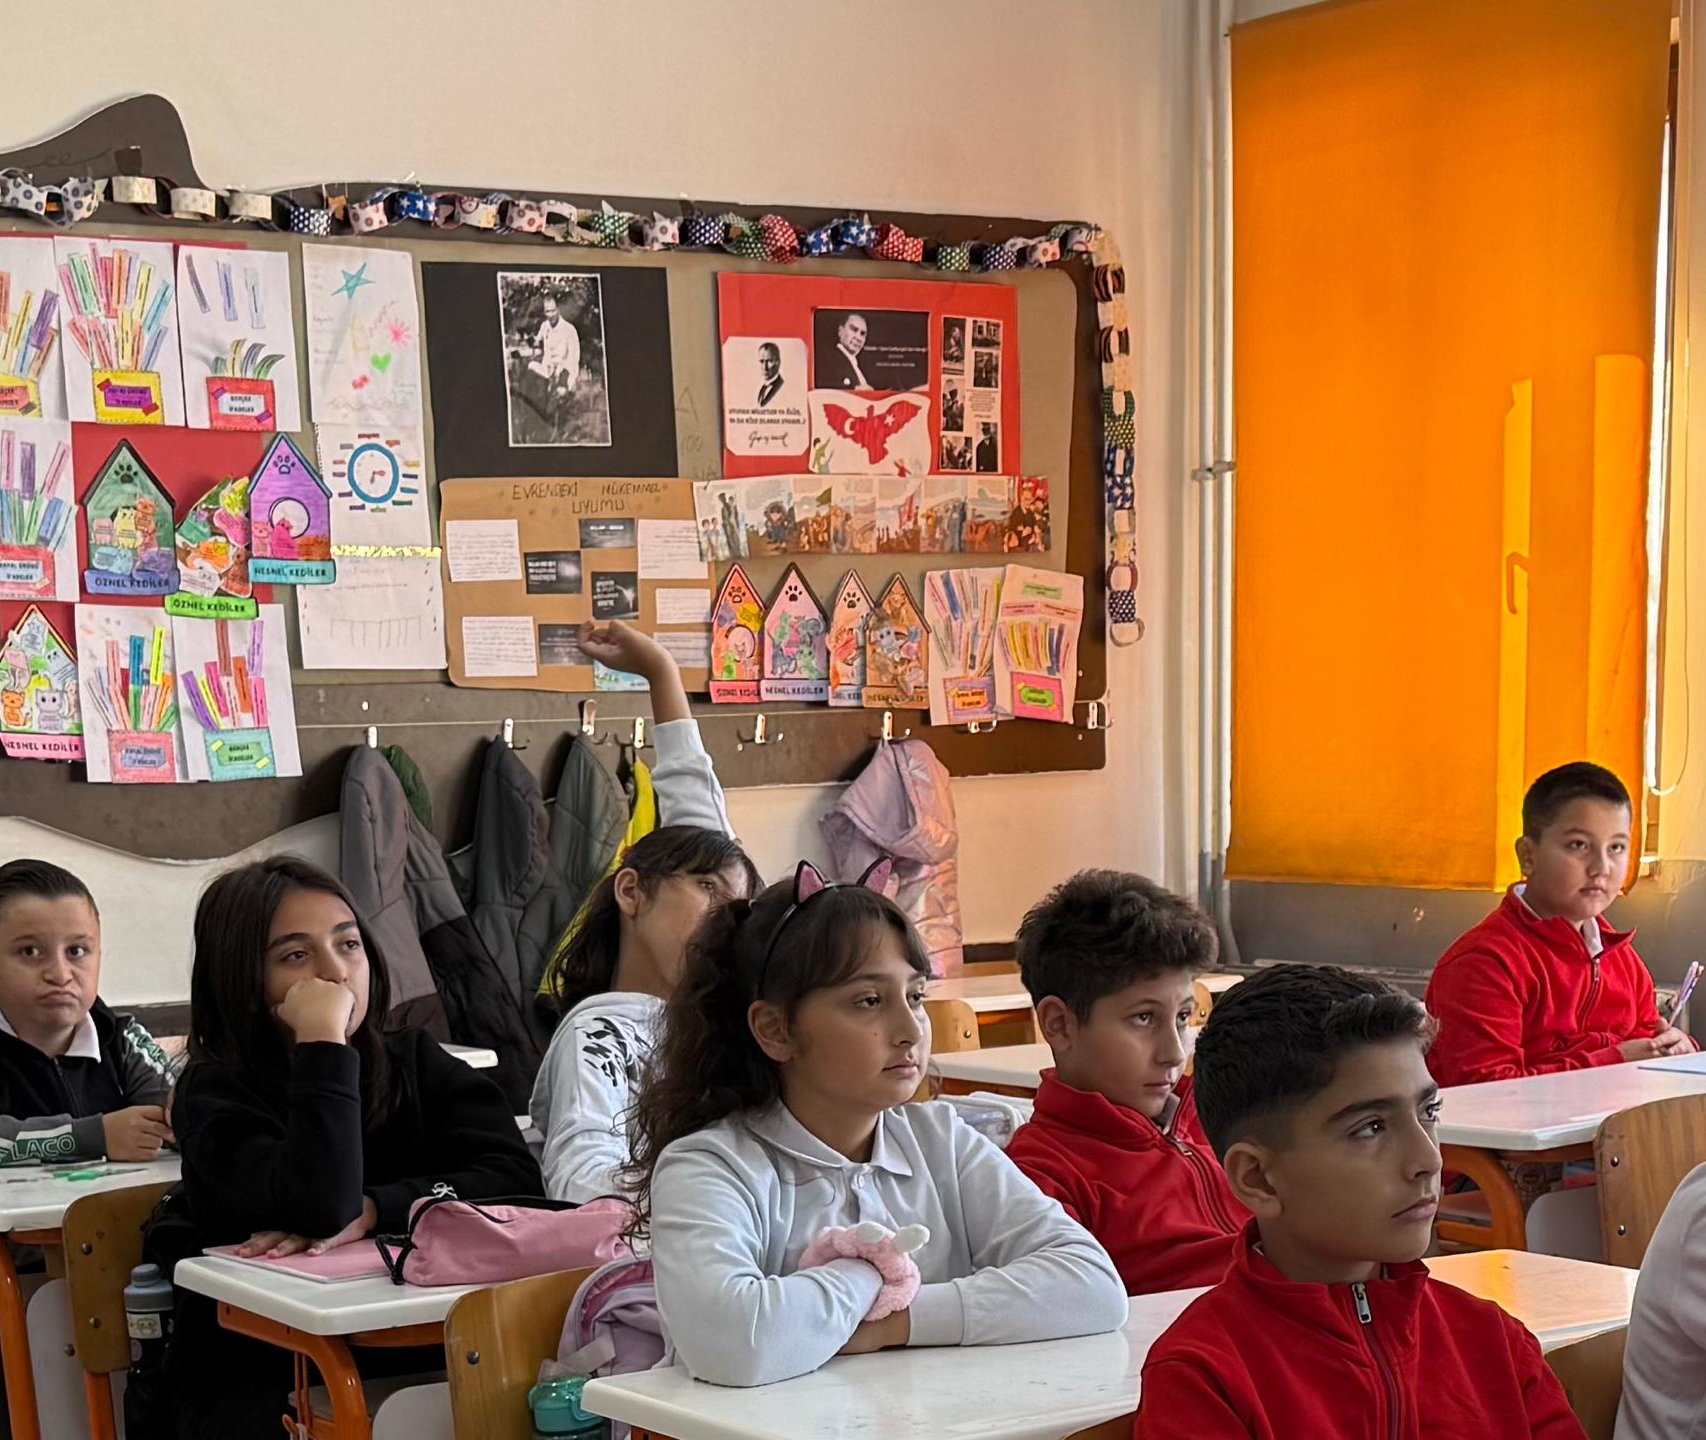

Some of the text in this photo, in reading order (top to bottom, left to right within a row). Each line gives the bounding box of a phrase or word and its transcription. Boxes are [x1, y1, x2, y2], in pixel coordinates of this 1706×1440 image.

[571, 498, 624, 514] UYUMU
[254, 566, 327, 577] NESNEL KEDİLER
[94, 576, 127, 588] ÖZNEL
[173, 598, 247, 613] ÖZNEL KEDİLER
[42, 741, 81, 753] KEDİLER
